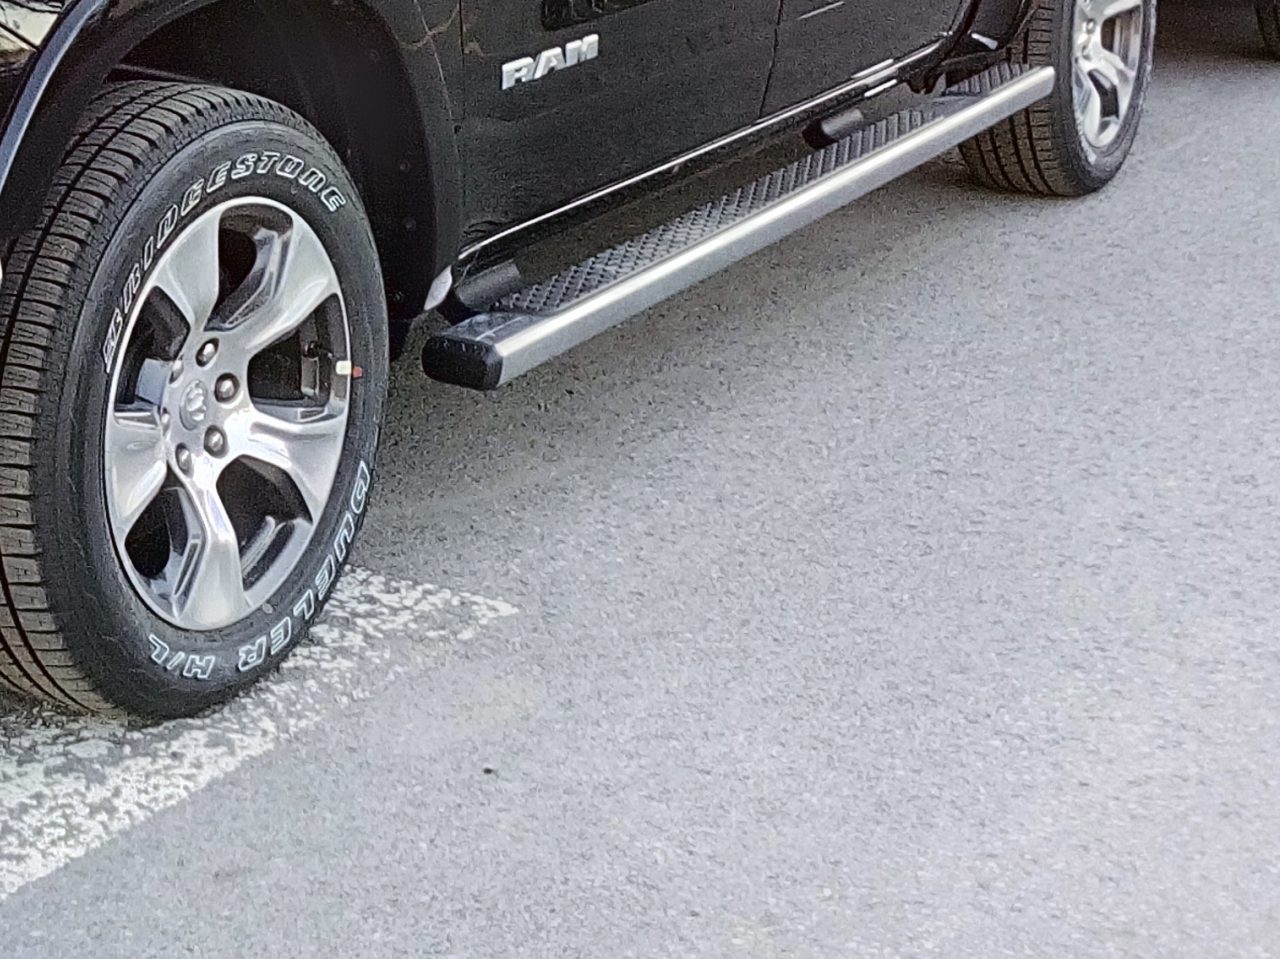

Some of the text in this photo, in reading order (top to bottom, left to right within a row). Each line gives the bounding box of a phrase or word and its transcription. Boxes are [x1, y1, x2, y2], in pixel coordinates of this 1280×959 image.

[501, 33, 600, 90] RAM
[103, 150, 347, 374] BRIDGESTONE
[237, 459, 371, 673] DUELER
